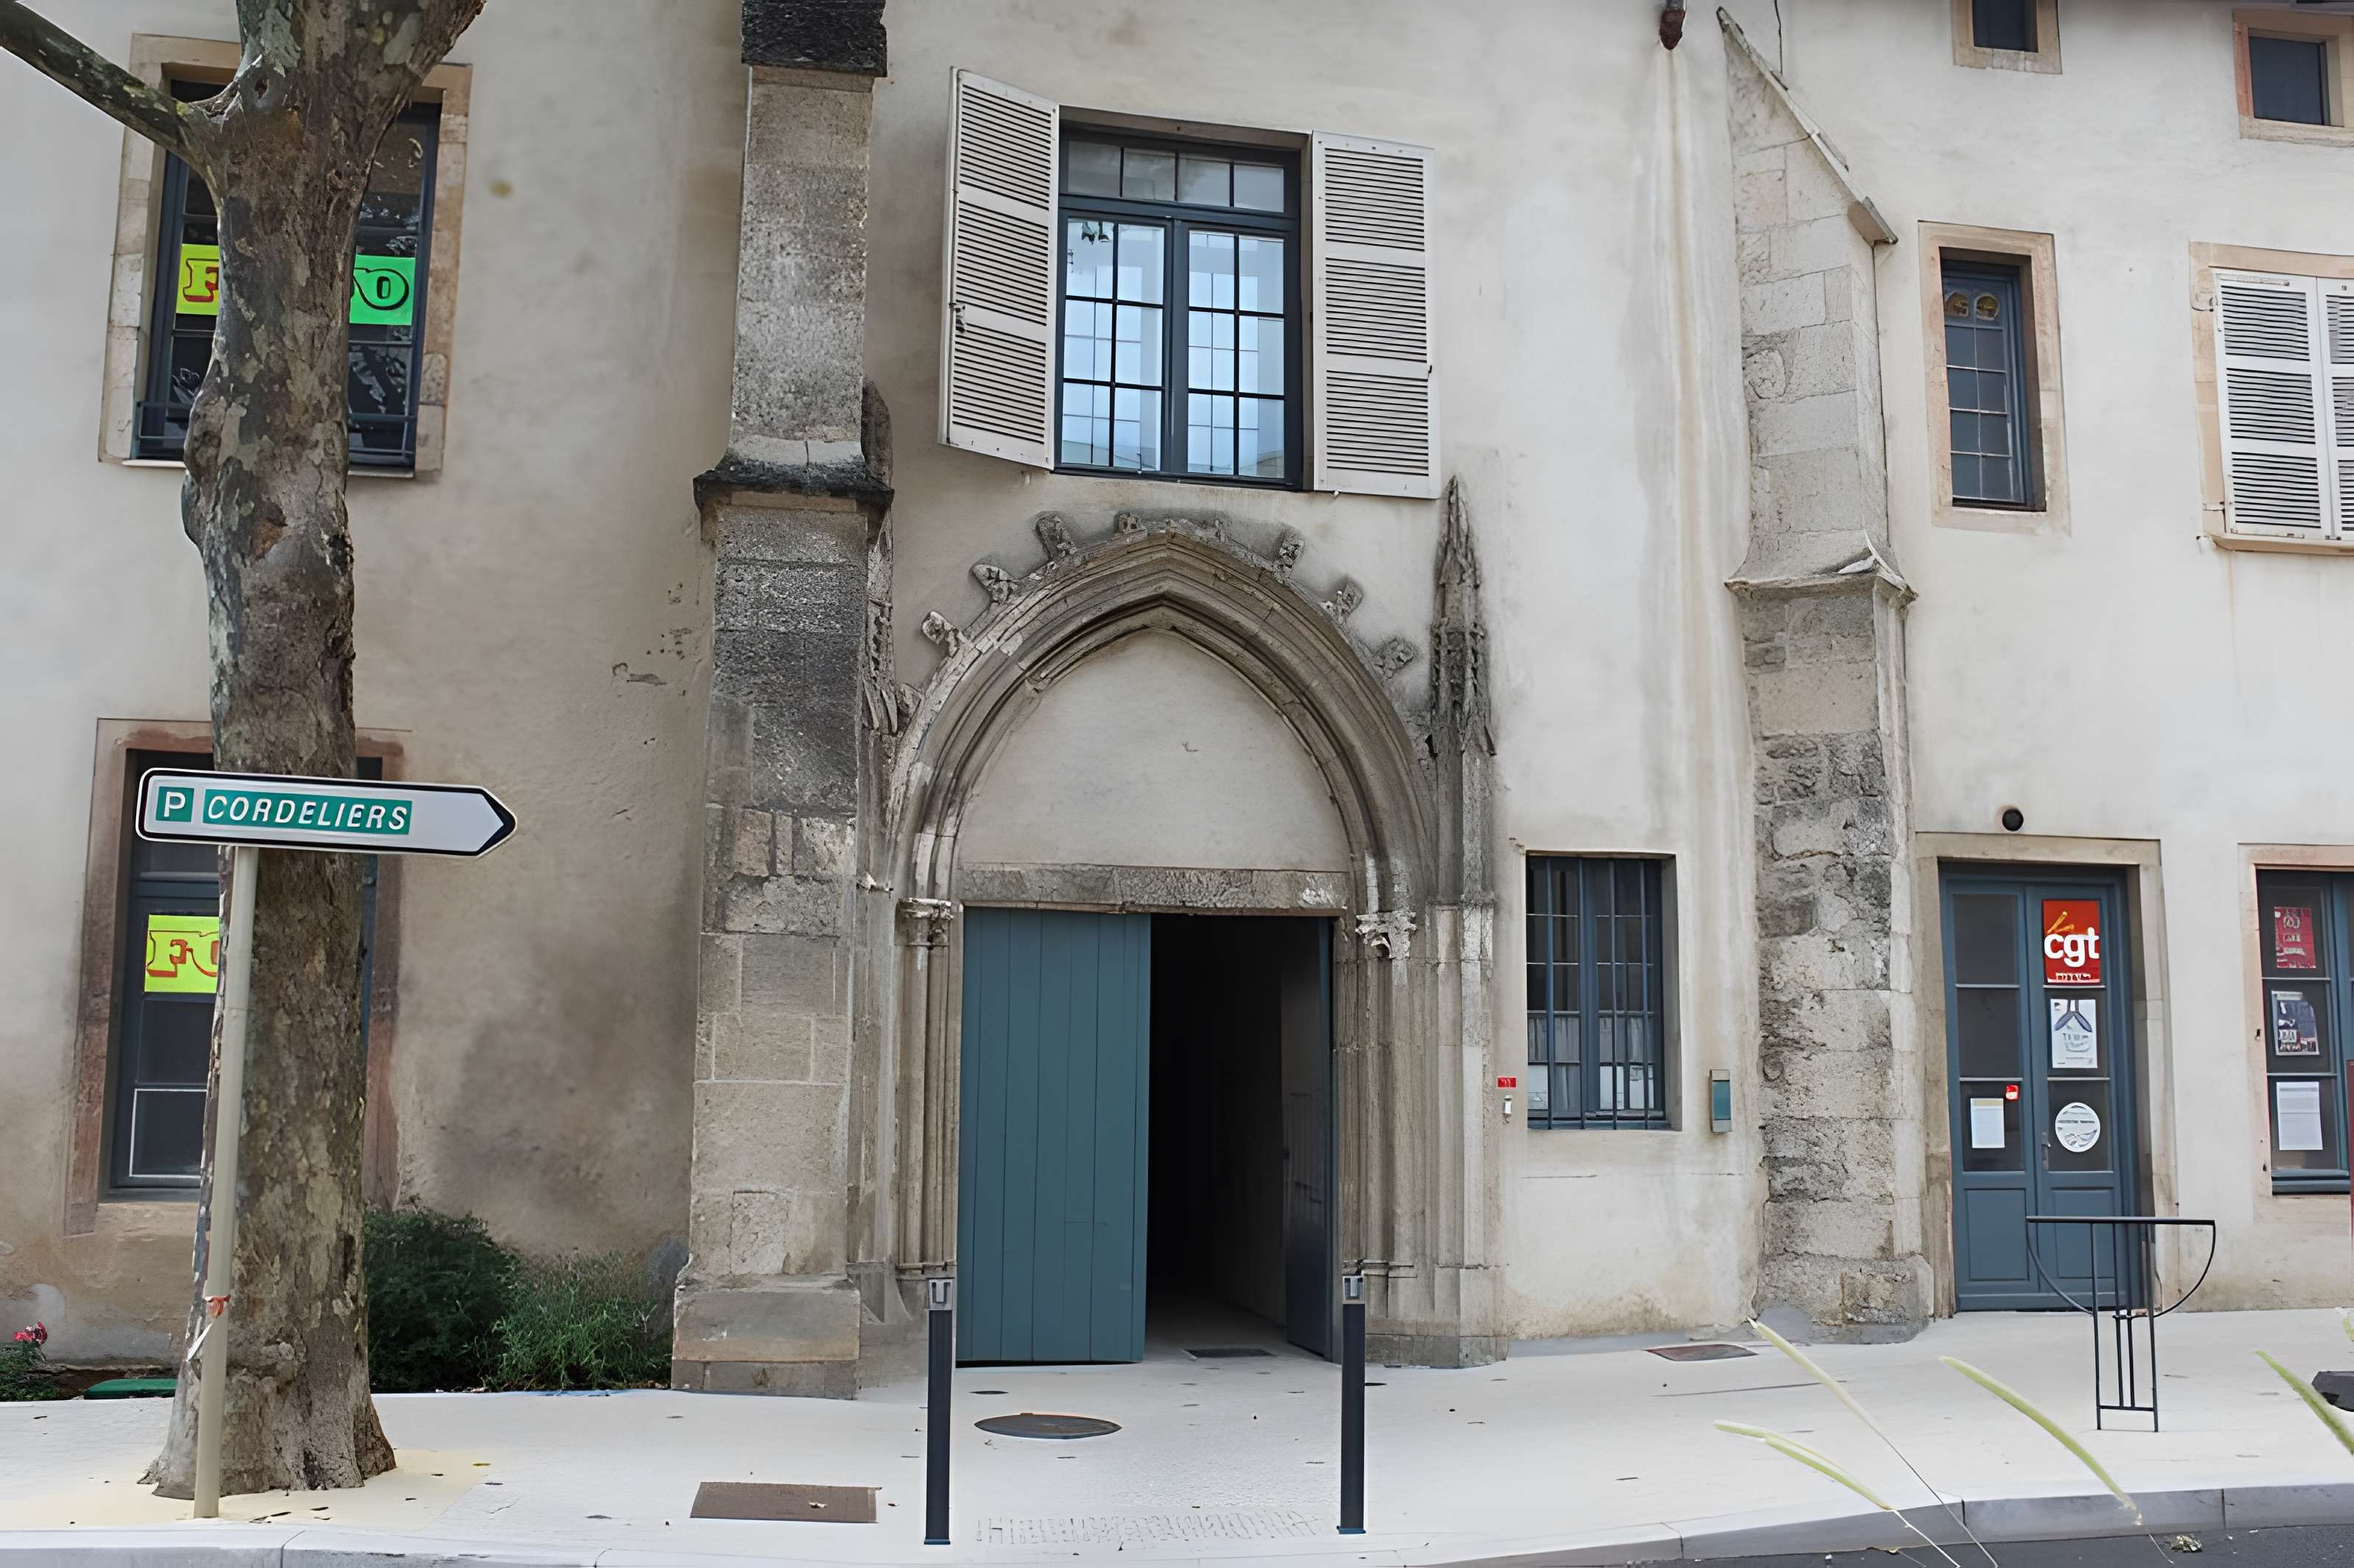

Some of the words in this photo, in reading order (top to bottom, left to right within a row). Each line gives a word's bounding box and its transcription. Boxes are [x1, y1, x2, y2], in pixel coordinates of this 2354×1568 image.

[163, 791, 186, 818] P
[207, 795, 408, 830] CORDELIERS
[2044, 927, 2099, 968] cgt
